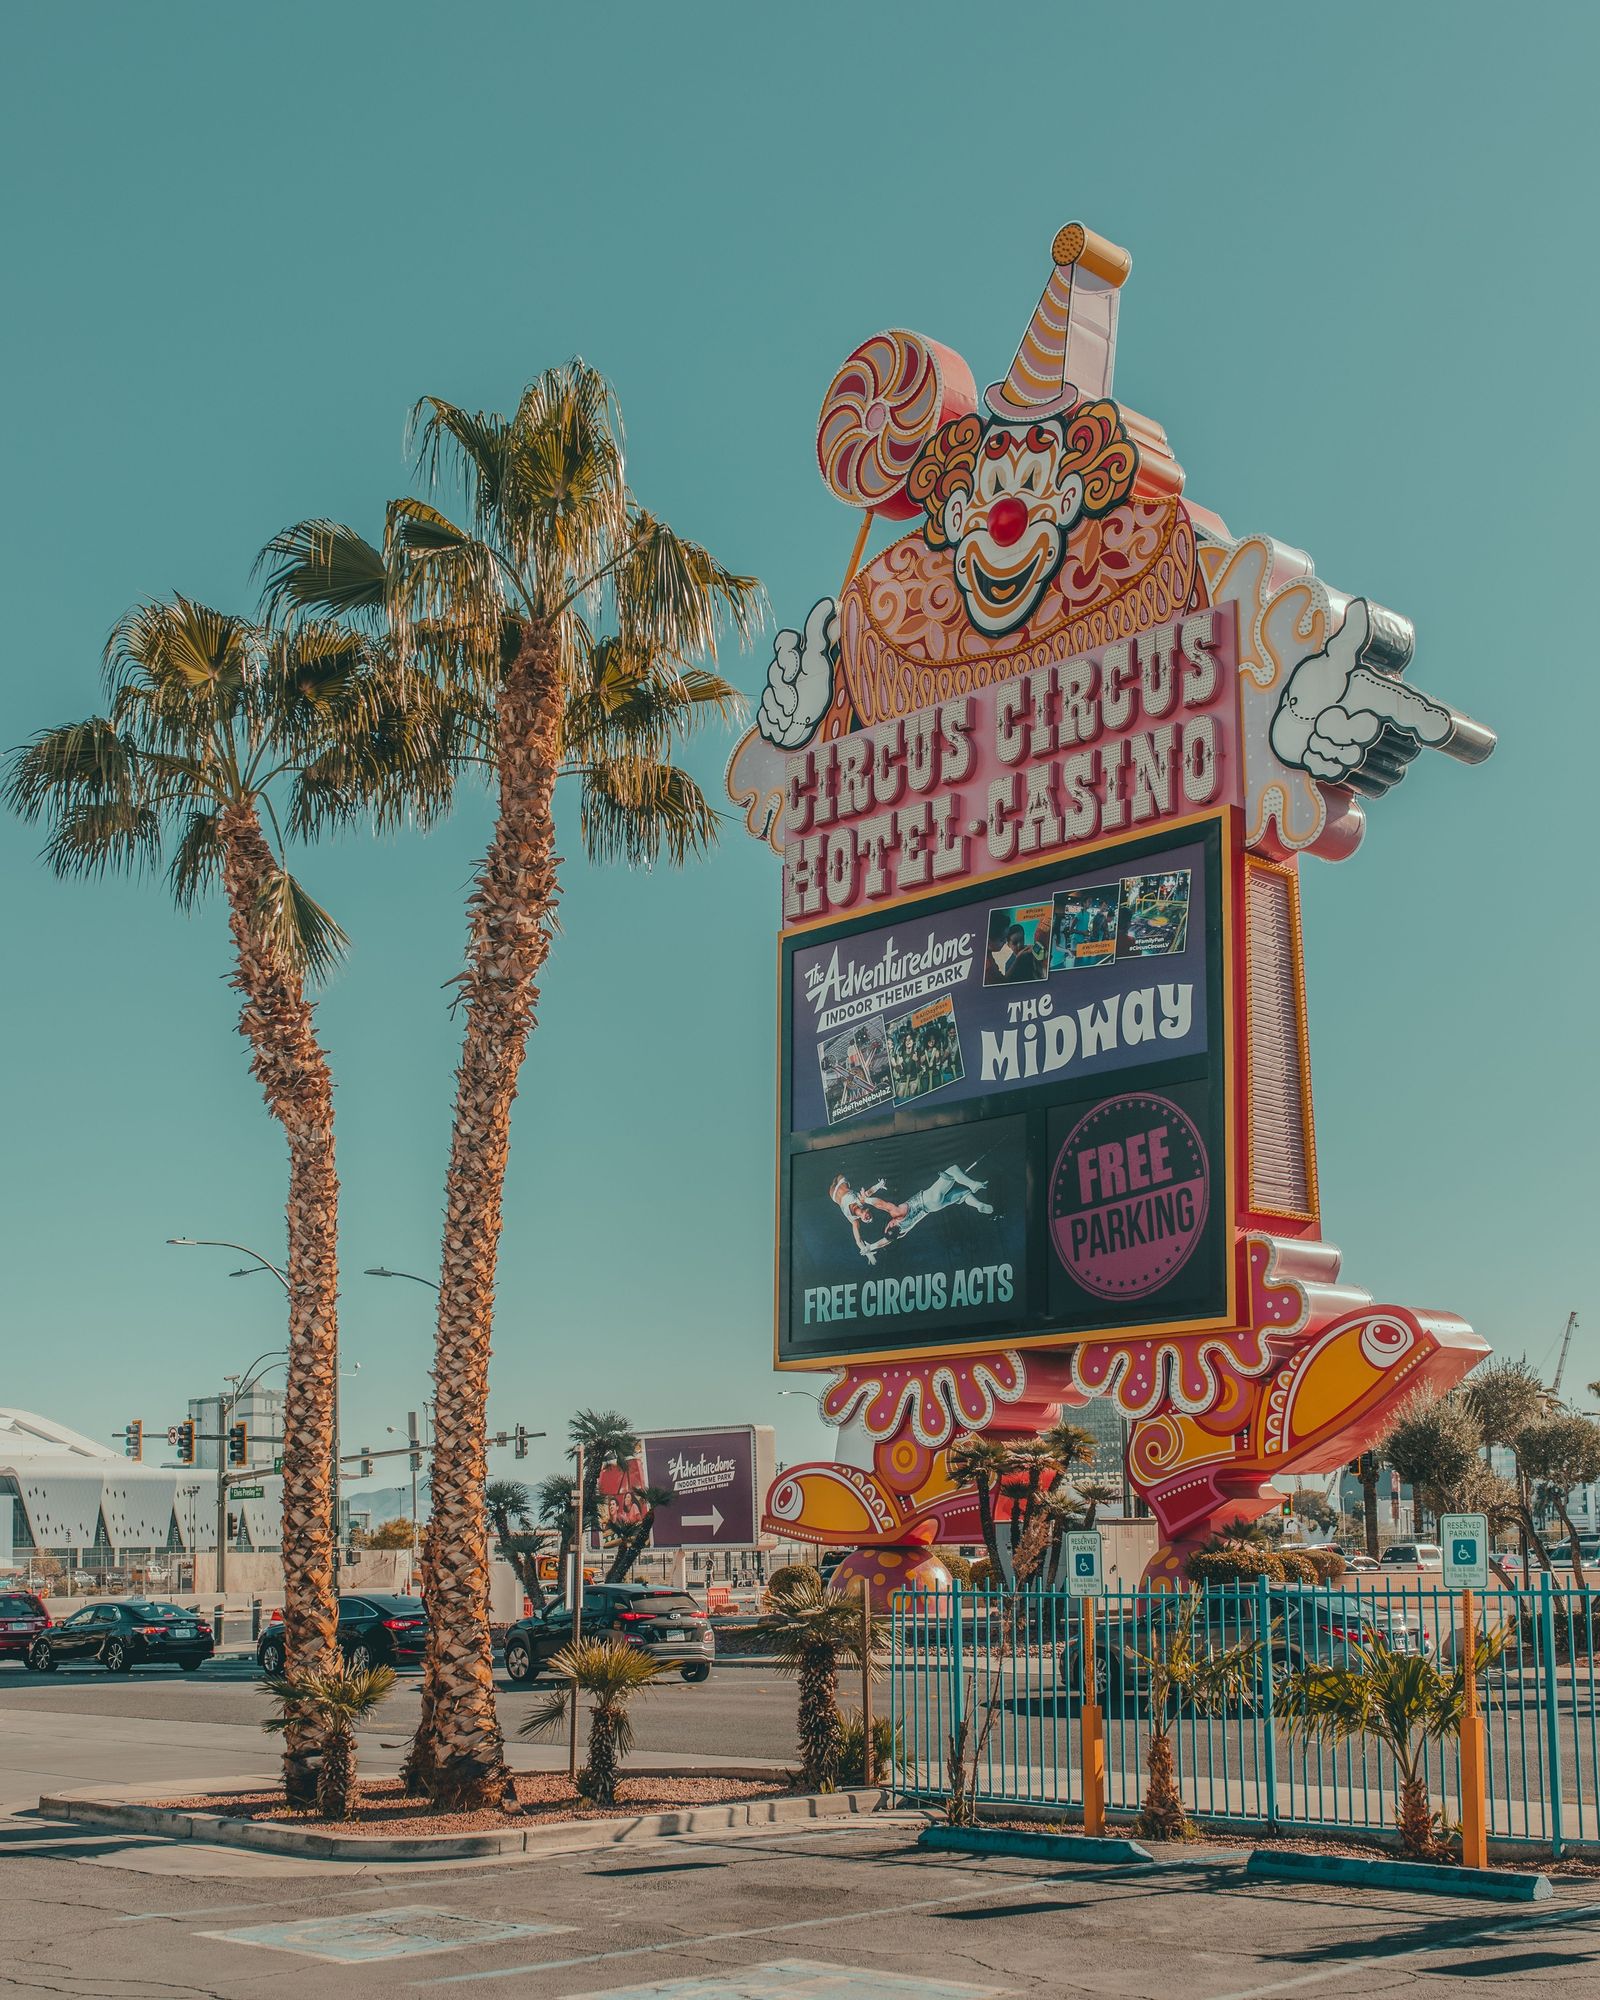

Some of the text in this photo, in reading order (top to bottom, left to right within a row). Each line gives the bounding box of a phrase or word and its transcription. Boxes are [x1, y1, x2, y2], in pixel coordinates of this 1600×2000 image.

[784, 611, 1221, 833] CIRCUS CIRCUS
[1135, 937, 1165, 945] #FamilyFun
[804, 931, 974, 1014] The Adventuredome
[826, 964, 964, 1027] INDOOR THEME PARK
[831, 1086, 892, 1117] #RideTheNebulaZ
[1076, 1126, 1175, 1204] FREE
[1071, 1187, 1196, 1263] PARKING
[803, 1263, 1014, 1325] FREE CIRCUS ACTS
[668, 1451, 736, 1482] The Adventuredome
[677, 1472, 732, 1488] INDOOR THEME PARK
[233, 1488, 243, 1497] Elvis
[1073, 1545, 1096, 1553] PARKING
